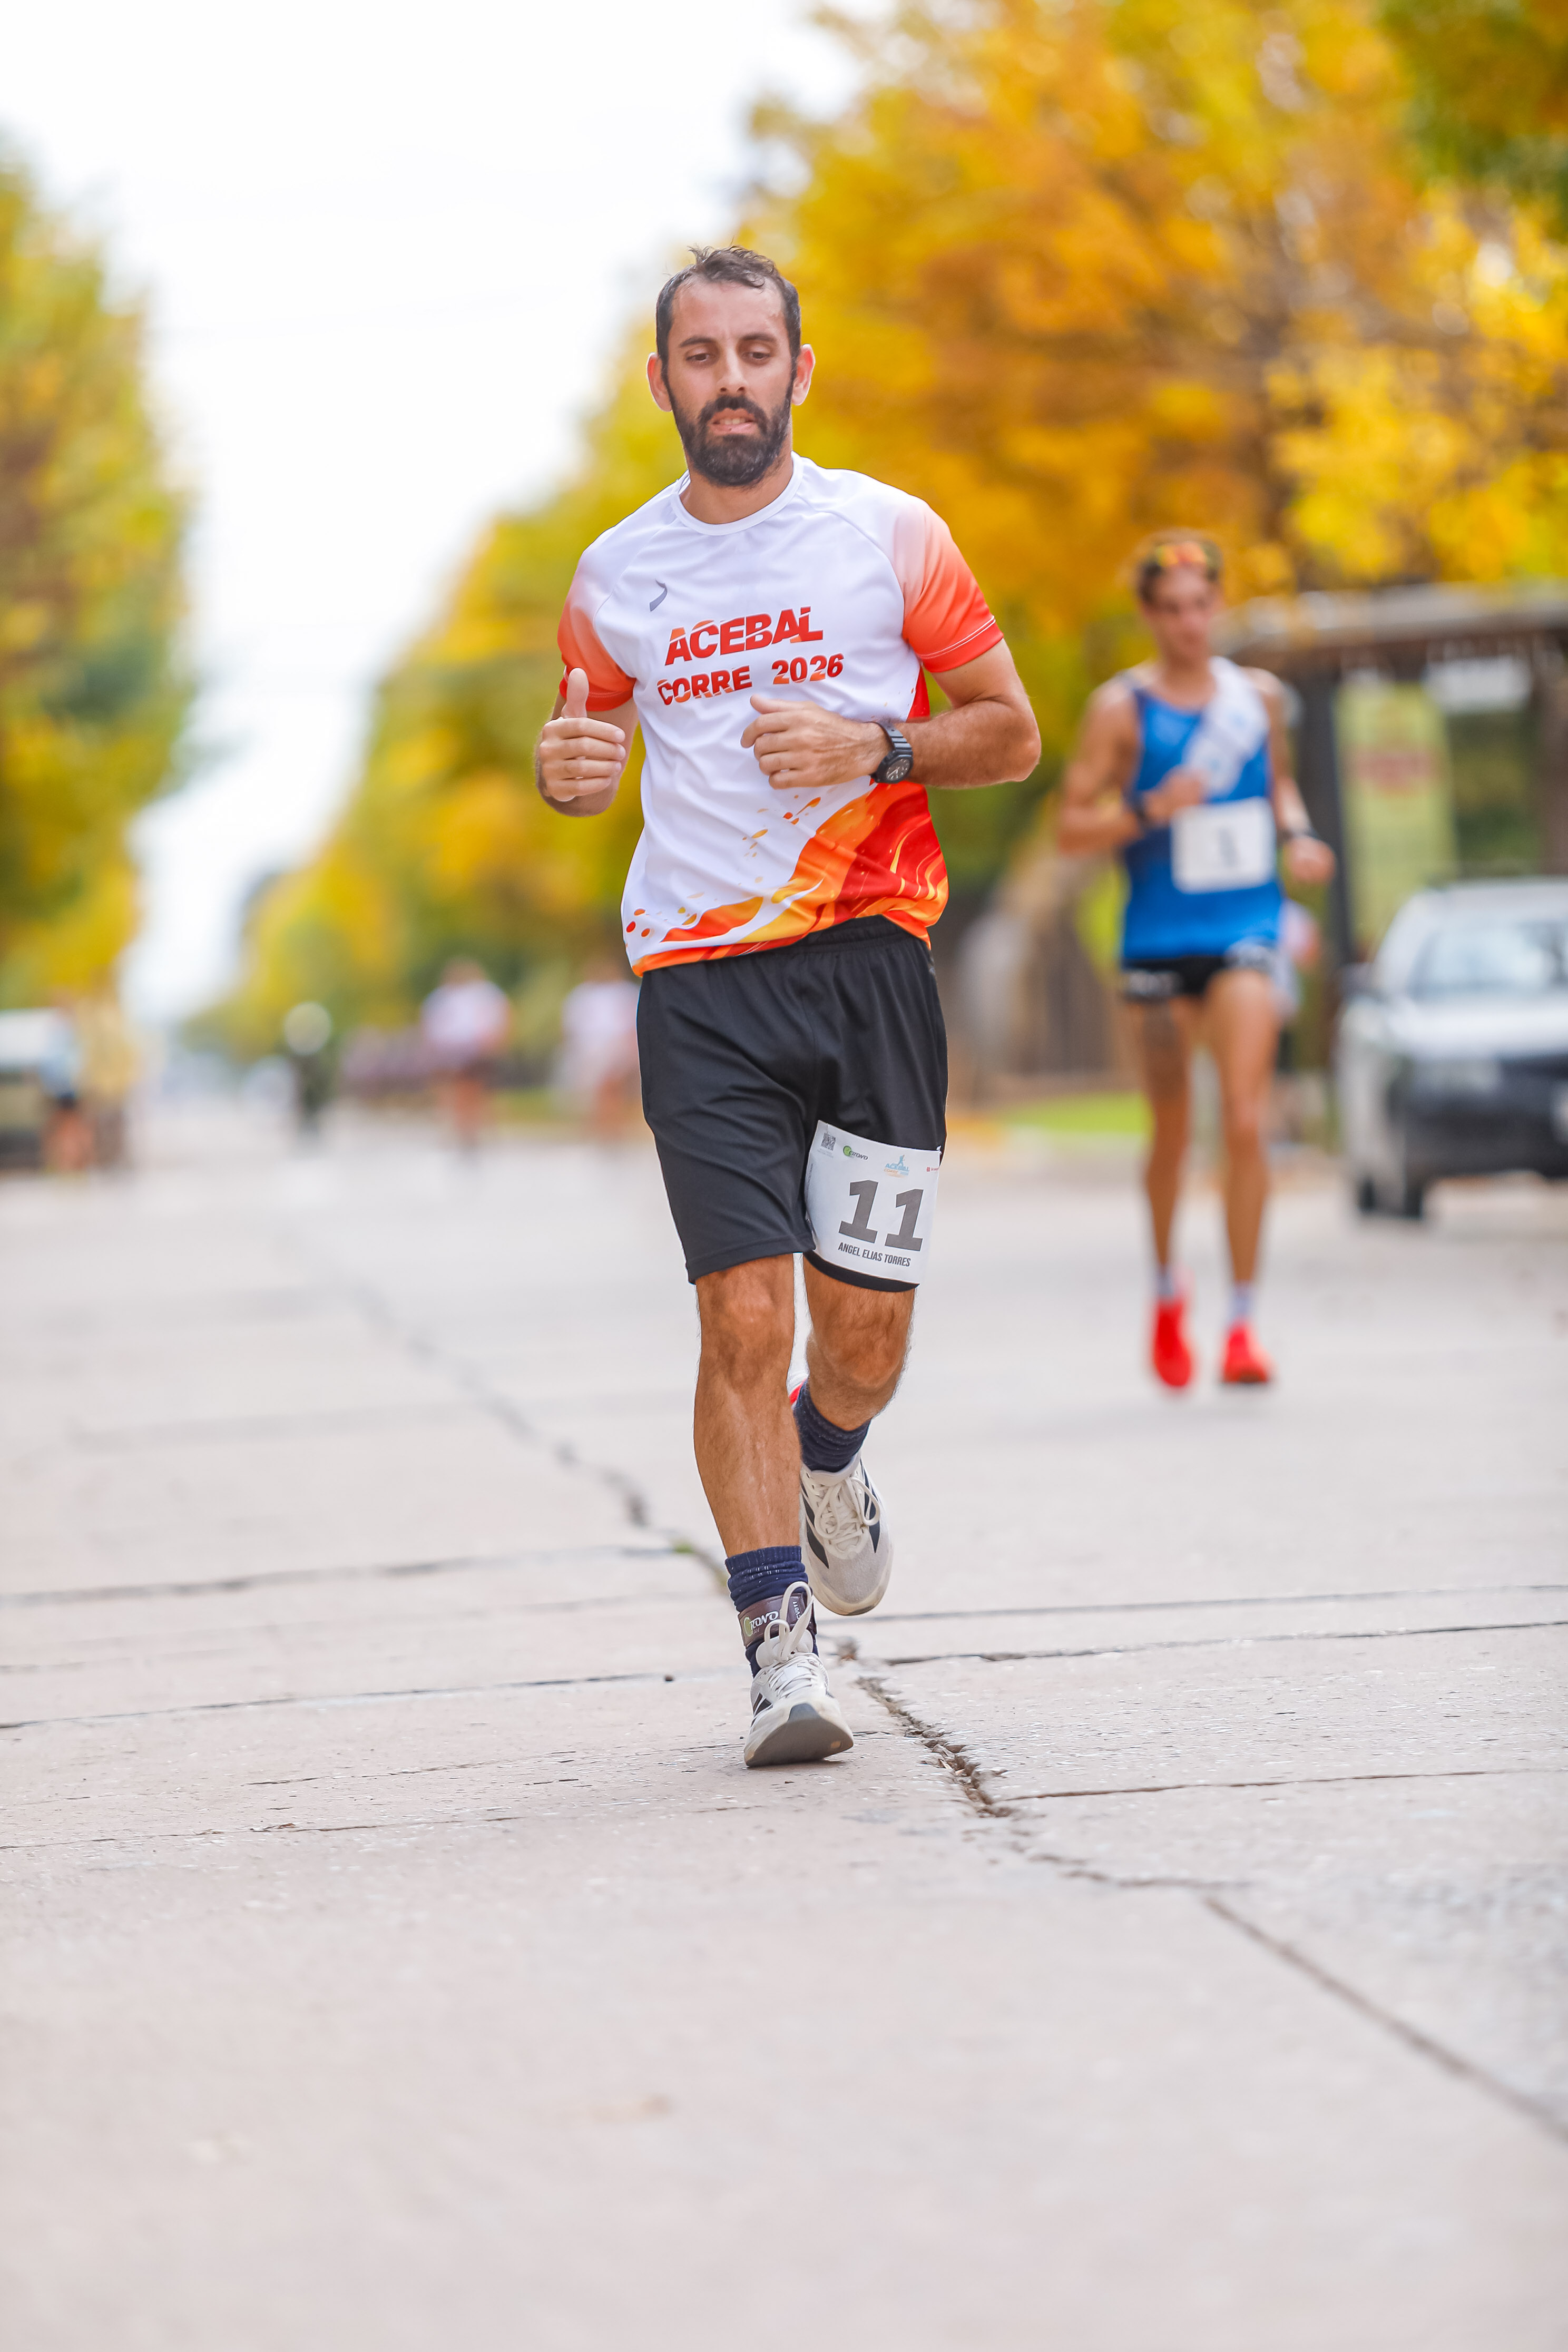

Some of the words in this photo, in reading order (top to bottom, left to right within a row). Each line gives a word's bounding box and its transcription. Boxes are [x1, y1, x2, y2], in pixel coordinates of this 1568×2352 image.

[665, 606, 823, 666] ACEBAL
[656, 665, 752, 705] CORRE
[771, 653, 844, 685] 2026
[839, 1180, 924, 1251] 11
[838, 1242, 860, 1257] ANGEL
[862, 1249, 883, 1261] ELIAS
[884, 1254, 911, 1267] TORRES
